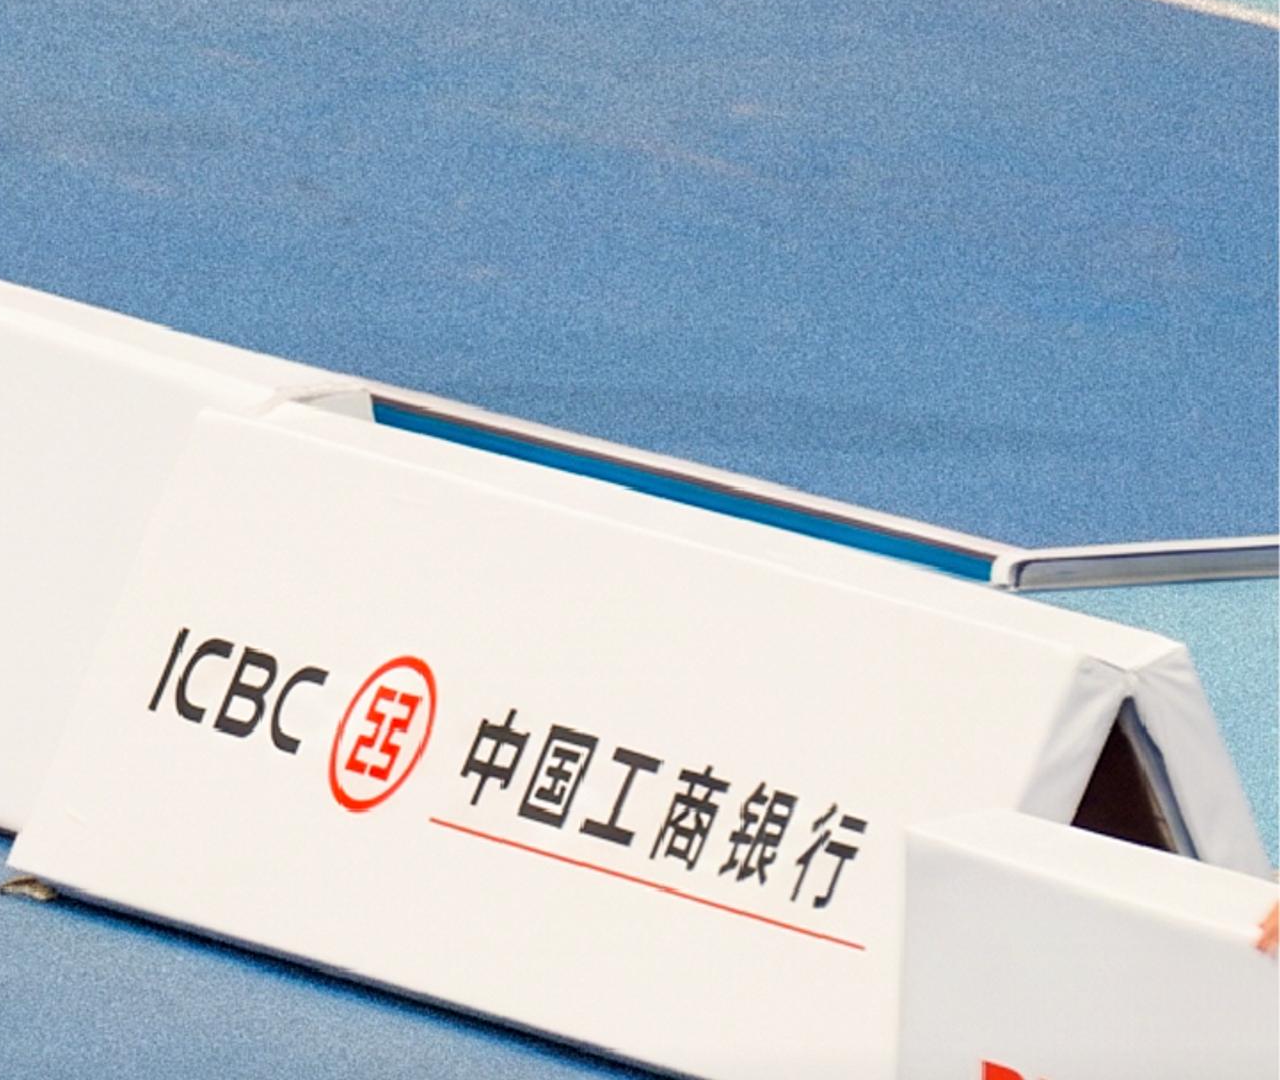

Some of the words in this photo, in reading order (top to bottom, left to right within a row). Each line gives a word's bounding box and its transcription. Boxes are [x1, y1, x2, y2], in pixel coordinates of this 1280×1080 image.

[148, 627, 329, 756] ICBC
[459, 708, 868, 910] 中国工商银行
